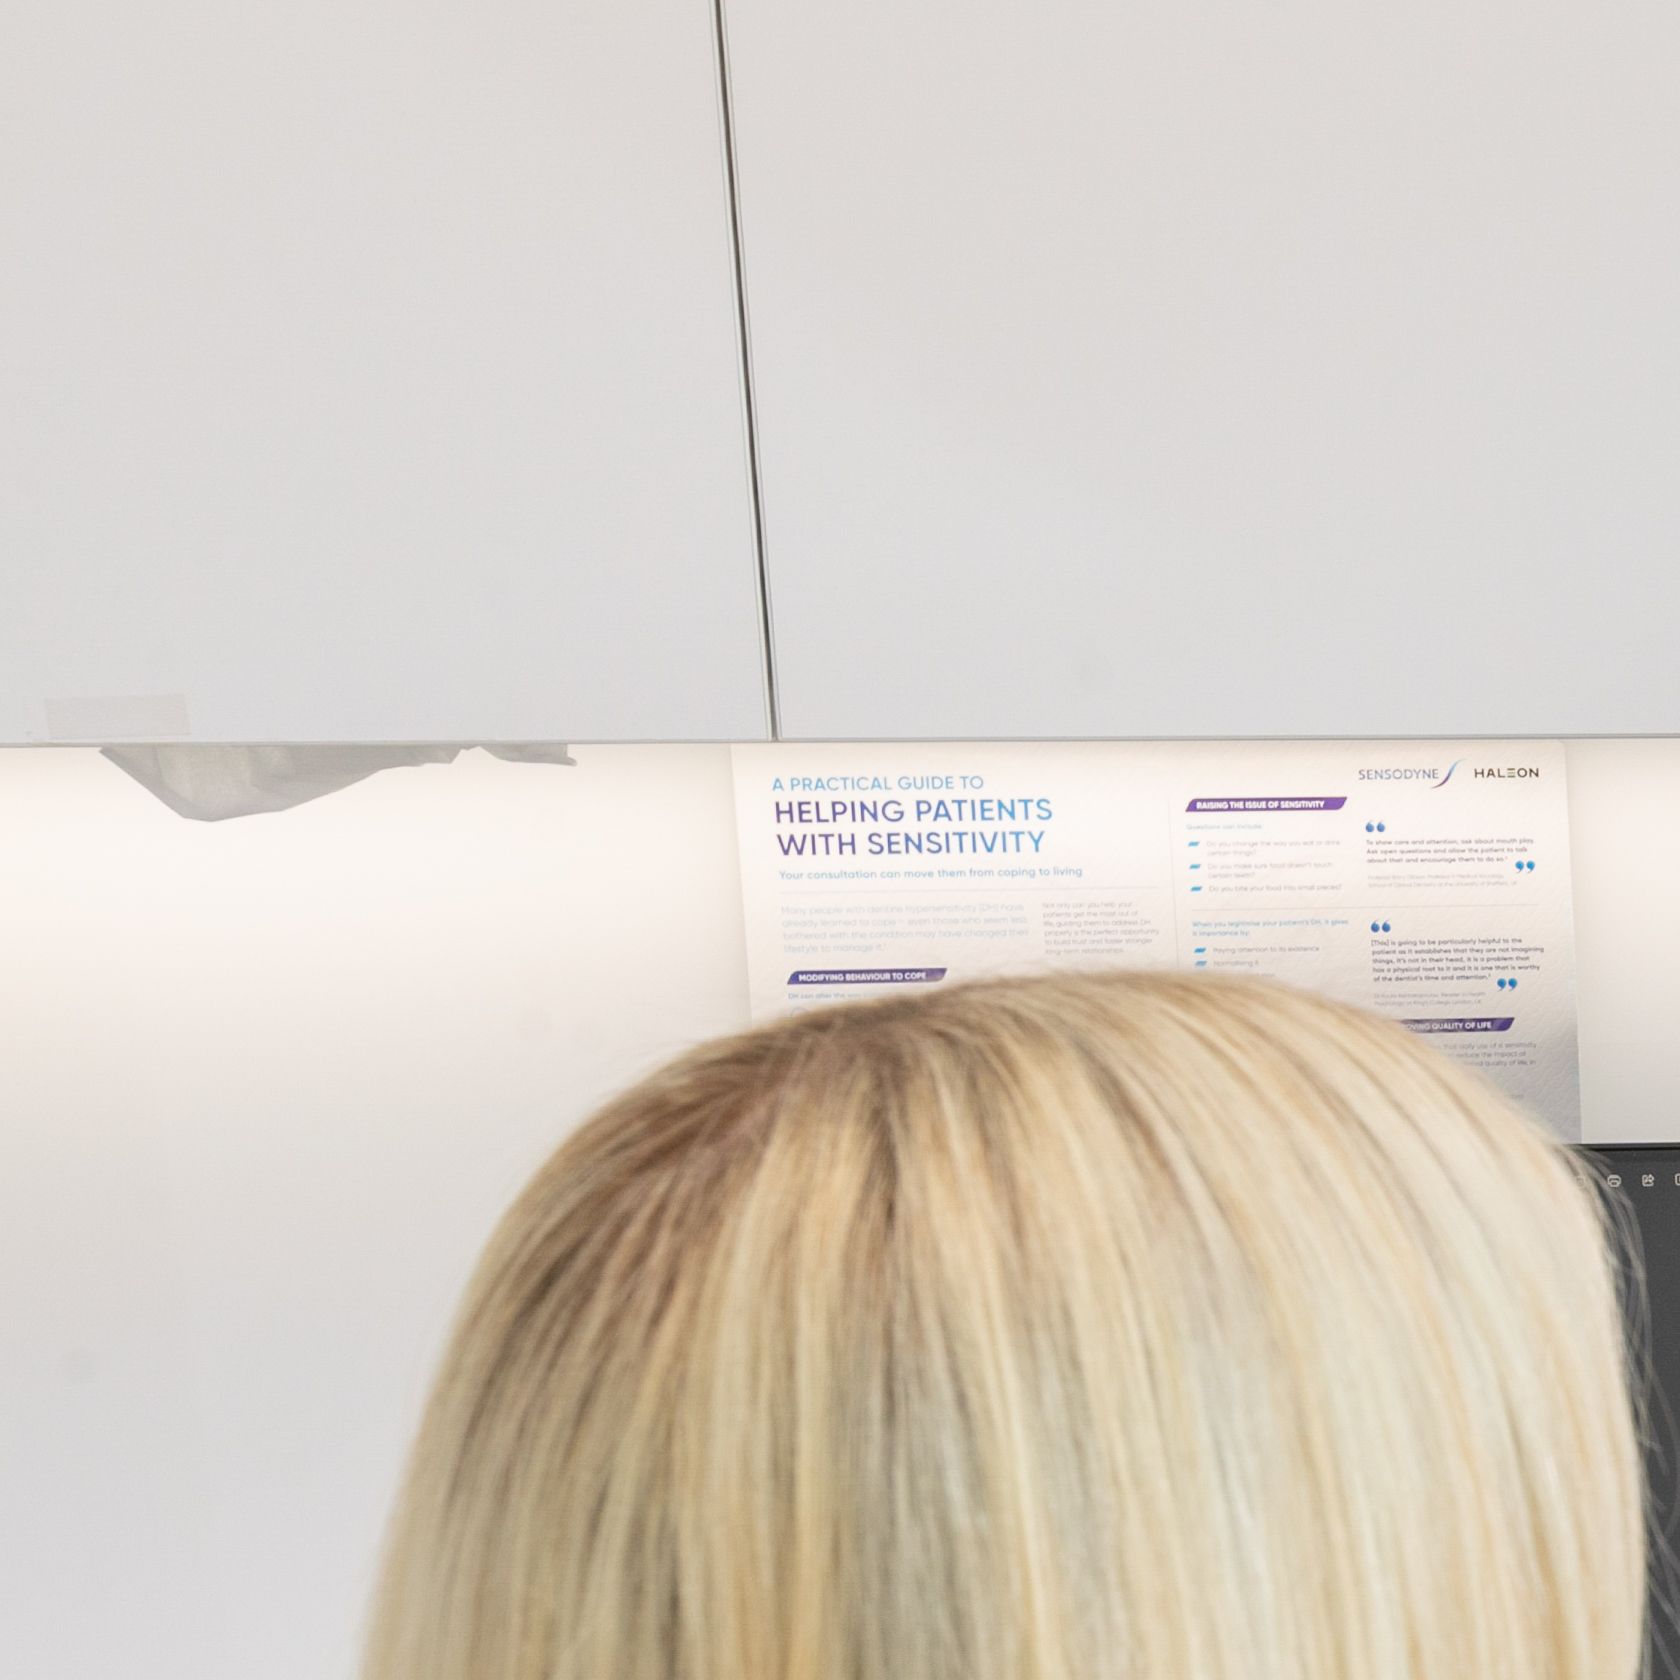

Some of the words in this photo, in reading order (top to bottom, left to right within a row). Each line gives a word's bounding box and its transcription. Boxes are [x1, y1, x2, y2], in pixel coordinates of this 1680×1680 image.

[1359, 768, 1439, 780] SENSODYNE
[1475, 768, 1539, 779] HALEON
[773, 778, 784, 791] A
[791, 777, 891, 791] PRACTICAL
[898, 776, 954, 790] GUIDE
[960, 776, 983, 789] TO
[776, 801, 904, 823] HELPING
[916, 798, 1053, 822] PATIENTS
[1197, 801, 1228, 809] RAISING
[1280, 800, 1324, 808] SENSITIVITY
[777, 833, 856, 855] WITH
[868, 830, 1045, 854] SENSITIVITY
[780, 871, 803, 880] Your
[807, 870, 876, 880] consultation
[880, 870, 900, 879] can
[904, 870, 934, 878] move
[937, 868, 966, 878] them
[969, 868, 994, 878] from
[998, 868, 1035, 879] coping
[1039, 868, 1049, 876] to
[1053, 867, 1082, 877] living
[799, 973, 843, 982] MODIFYING
[846, 972, 890, 981] BEHAVIOUR
[893, 972, 903, 980] TO
[905, 971, 926, 980] COPE
